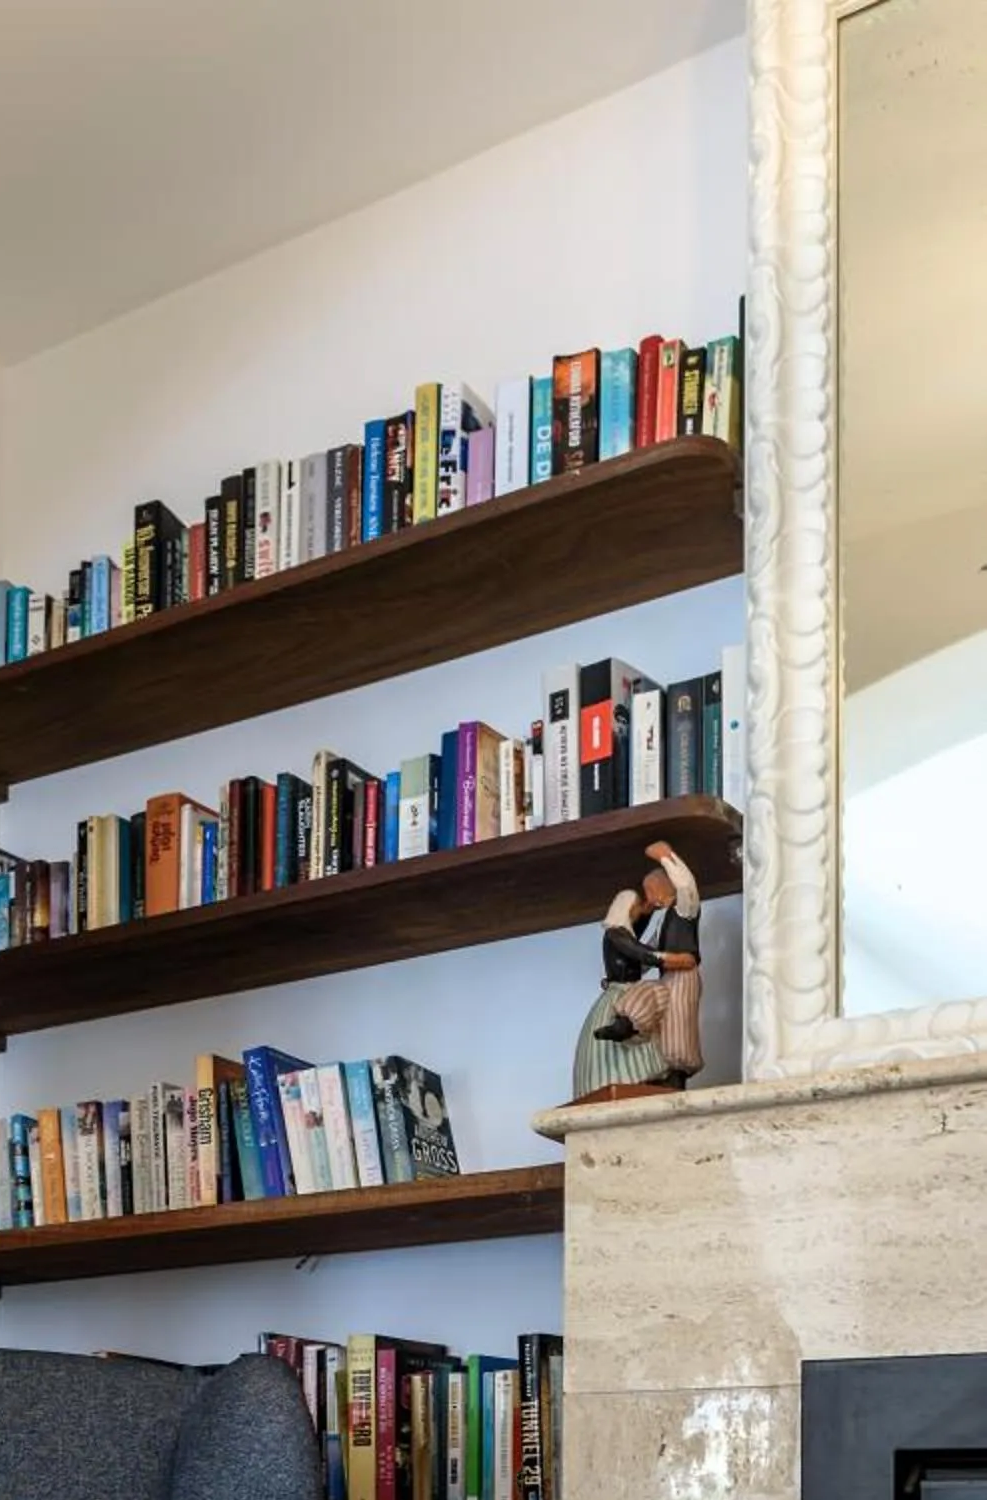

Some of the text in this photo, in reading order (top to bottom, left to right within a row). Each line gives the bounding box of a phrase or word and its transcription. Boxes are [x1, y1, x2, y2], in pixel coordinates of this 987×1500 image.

[439, 429, 458, 509] Le Fric
[298, 800, 306, 857] SLAUGHTER
[197, 1087, 214, 1145] Grisham
[411, 1137, 459, 1173] GROSS
[521, 1399, 540, 1463] TUNNEL
[523, 1465, 541, 1485] 29
